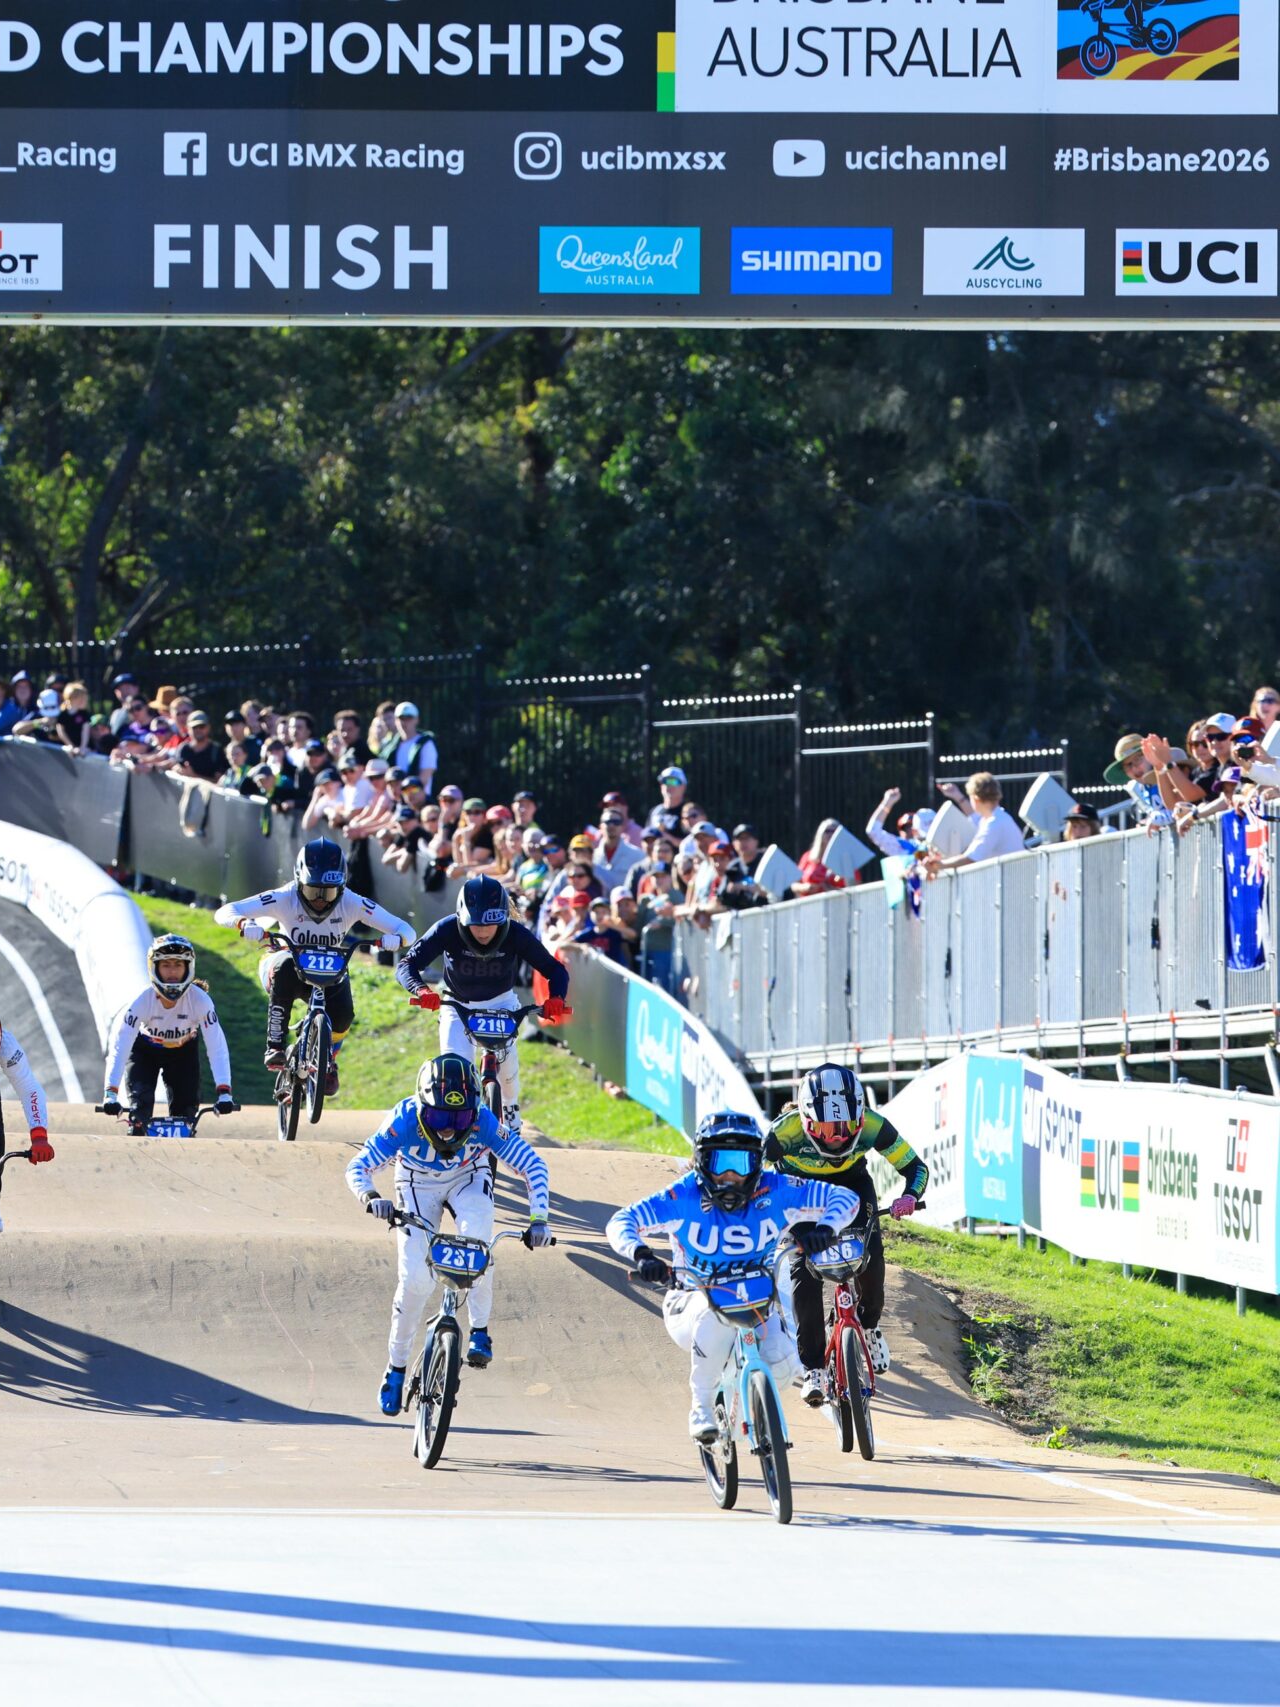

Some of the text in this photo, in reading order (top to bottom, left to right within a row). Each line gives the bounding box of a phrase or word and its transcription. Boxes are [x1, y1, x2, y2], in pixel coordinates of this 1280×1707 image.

[62, 21, 624, 75] CHAMPIONSHIPS
[707, 27, 1021, 77] AUSTRALIA
[229, 143, 465, 175] UCI BMX Racing
[582, 144, 726, 170] ucibmxsx
[845, 145, 1006, 170] ucichannel
[1054, 147, 1269, 171] #Brisbane2026
[154, 224, 449, 290] FINISH
[556, 234, 684, 273] Queensland
[741, 250, 882, 272] SHIMANO
[1151, 241, 1258, 284] UCI
[585, 274, 654, 286] AUSTRALIA
[966, 279, 1042, 289] AUSCYCLING
[308, 955, 334, 970] 212
[477, 1018, 506, 1033] 219
[31, 1091, 41, 1125] JAPAN
[832, 1101, 842, 1120] FLY
[1045, 1097, 1082, 1166] SPORT
[1097, 1139, 1120, 1211] UCI
[1147, 1125, 1198, 1201] brisbane
[1213, 1182, 1263, 1244] TISSOT
[687, 1217, 780, 1255] USA
[441, 1246, 476, 1269] 231
[736, 1282, 749, 1303] 4
